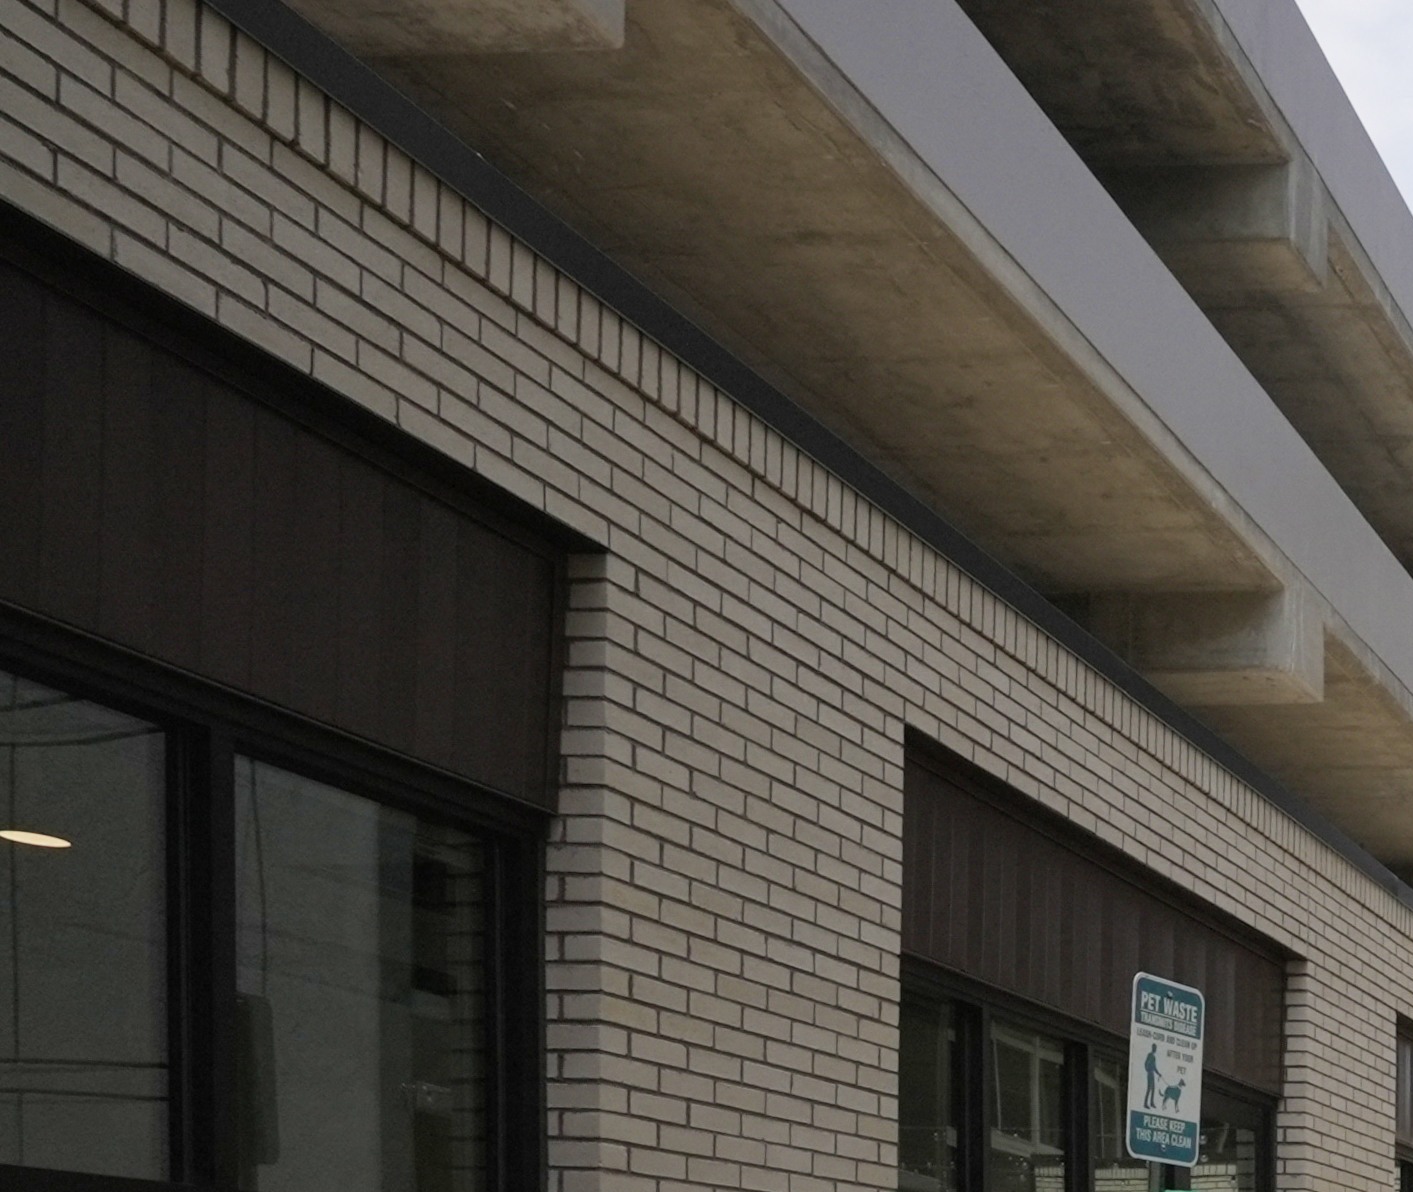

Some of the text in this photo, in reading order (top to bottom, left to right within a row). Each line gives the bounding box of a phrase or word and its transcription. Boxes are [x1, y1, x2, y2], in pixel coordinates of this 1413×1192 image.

[1141, 991, 1198, 1022] PET WASTE
[1182, 1054, 1193, 1063] YOUR
[1177, 1066, 1187, 1075] PET
[1143, 1115, 1186, 1133] PLEASE KEEP
[1136, 1128, 1192, 1149] THIS AREA CLEAN
